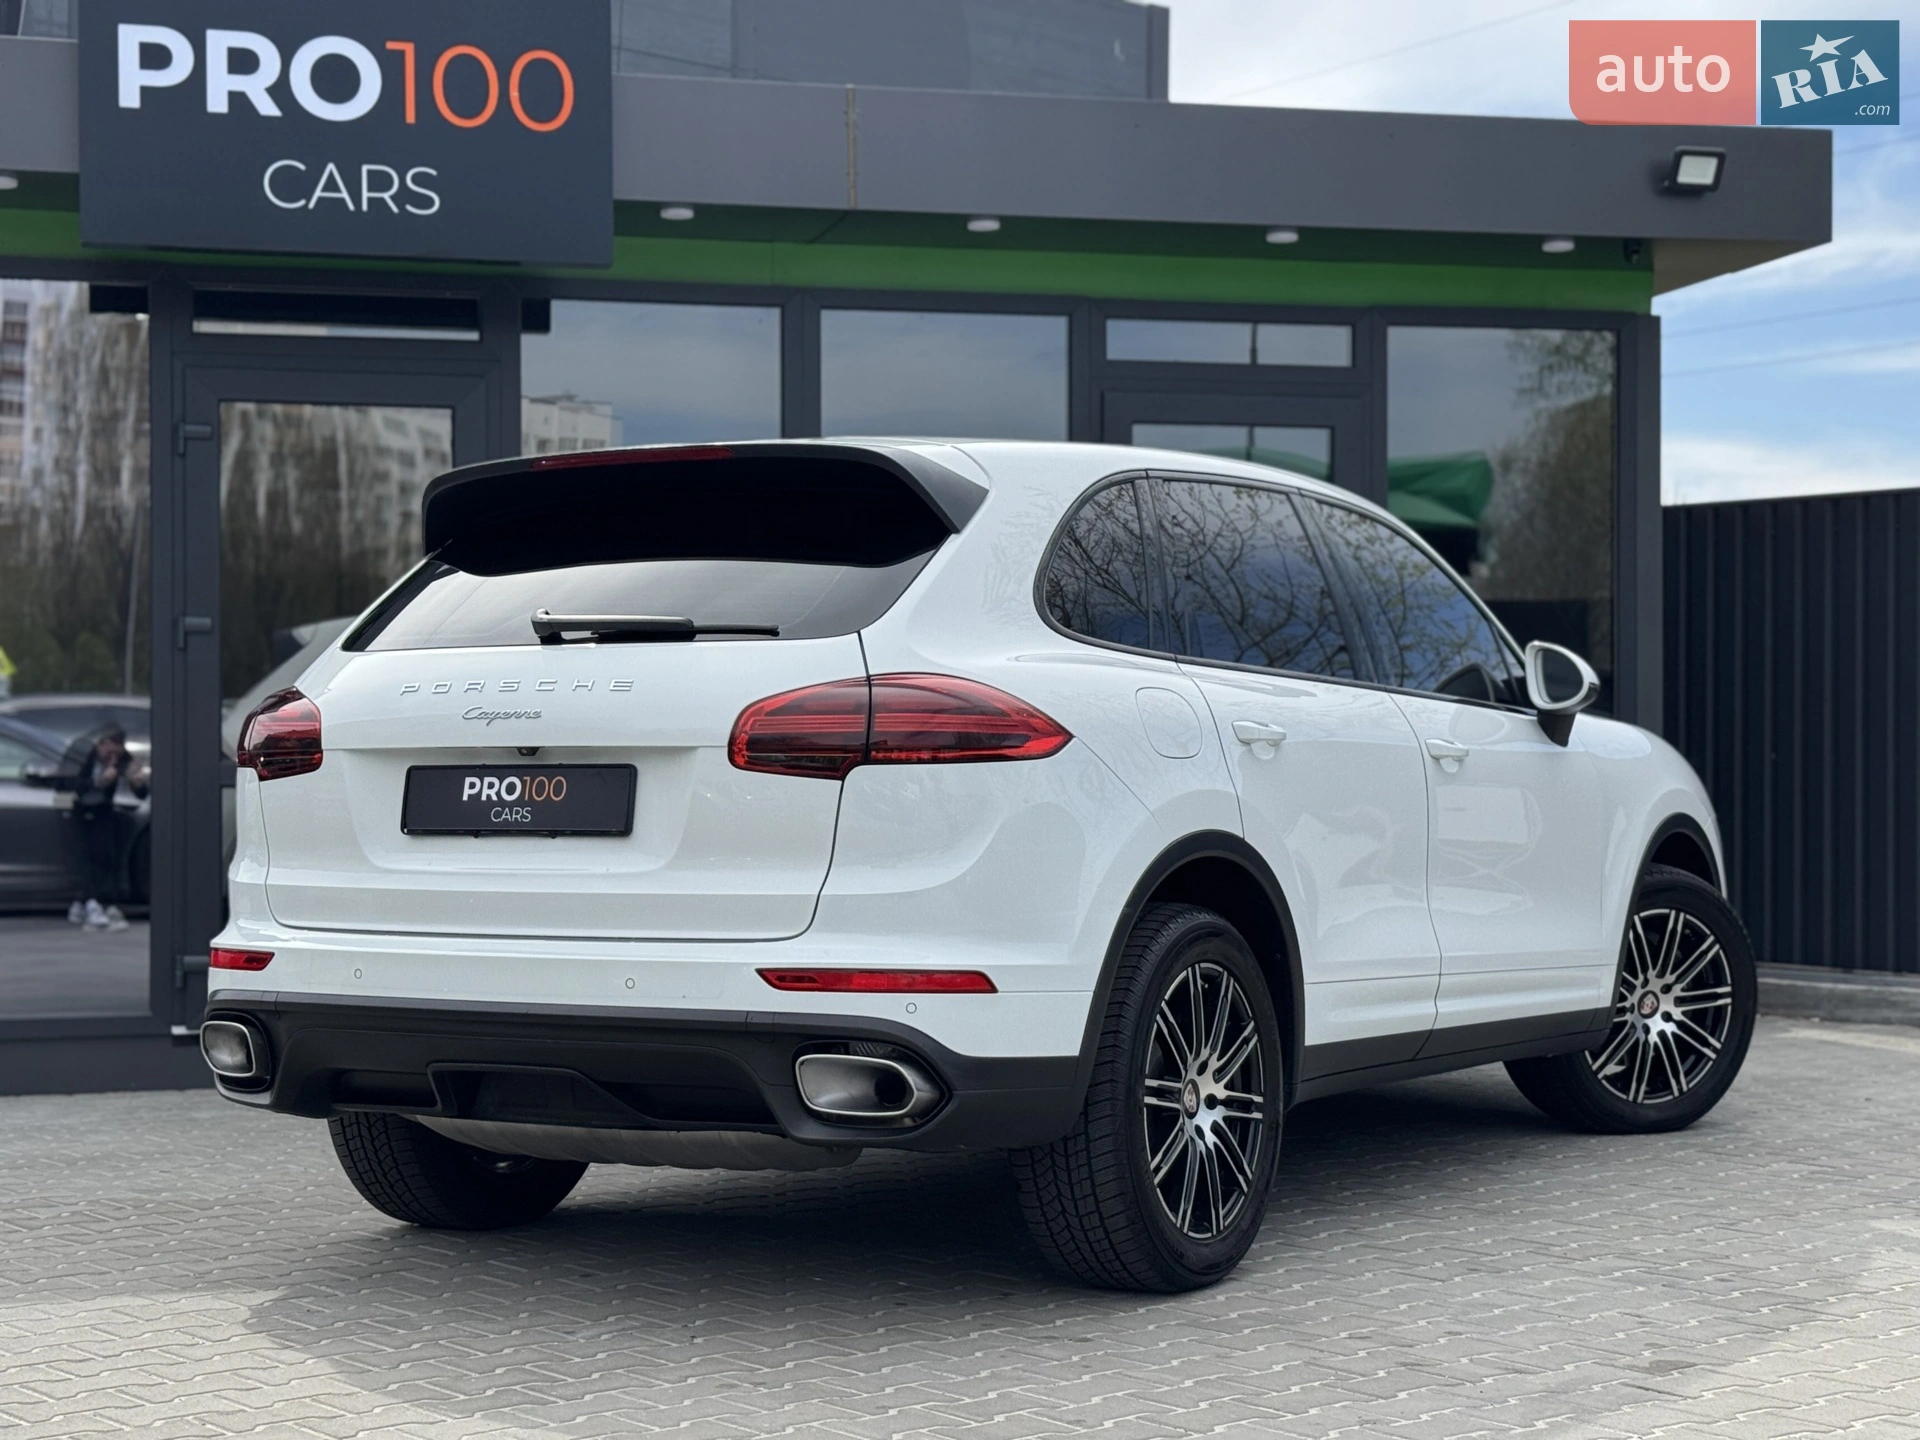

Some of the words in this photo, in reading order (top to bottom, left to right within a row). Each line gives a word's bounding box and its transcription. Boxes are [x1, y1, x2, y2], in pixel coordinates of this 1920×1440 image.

[117, 23, 575, 132] PRO100
[263, 159, 441, 215] CARS
[400, 679, 634, 695] PORSCHE
[462, 705, 542, 726] Cayenne
[462, 776, 567, 801] PRO100
[490, 807, 532, 822] CARS
